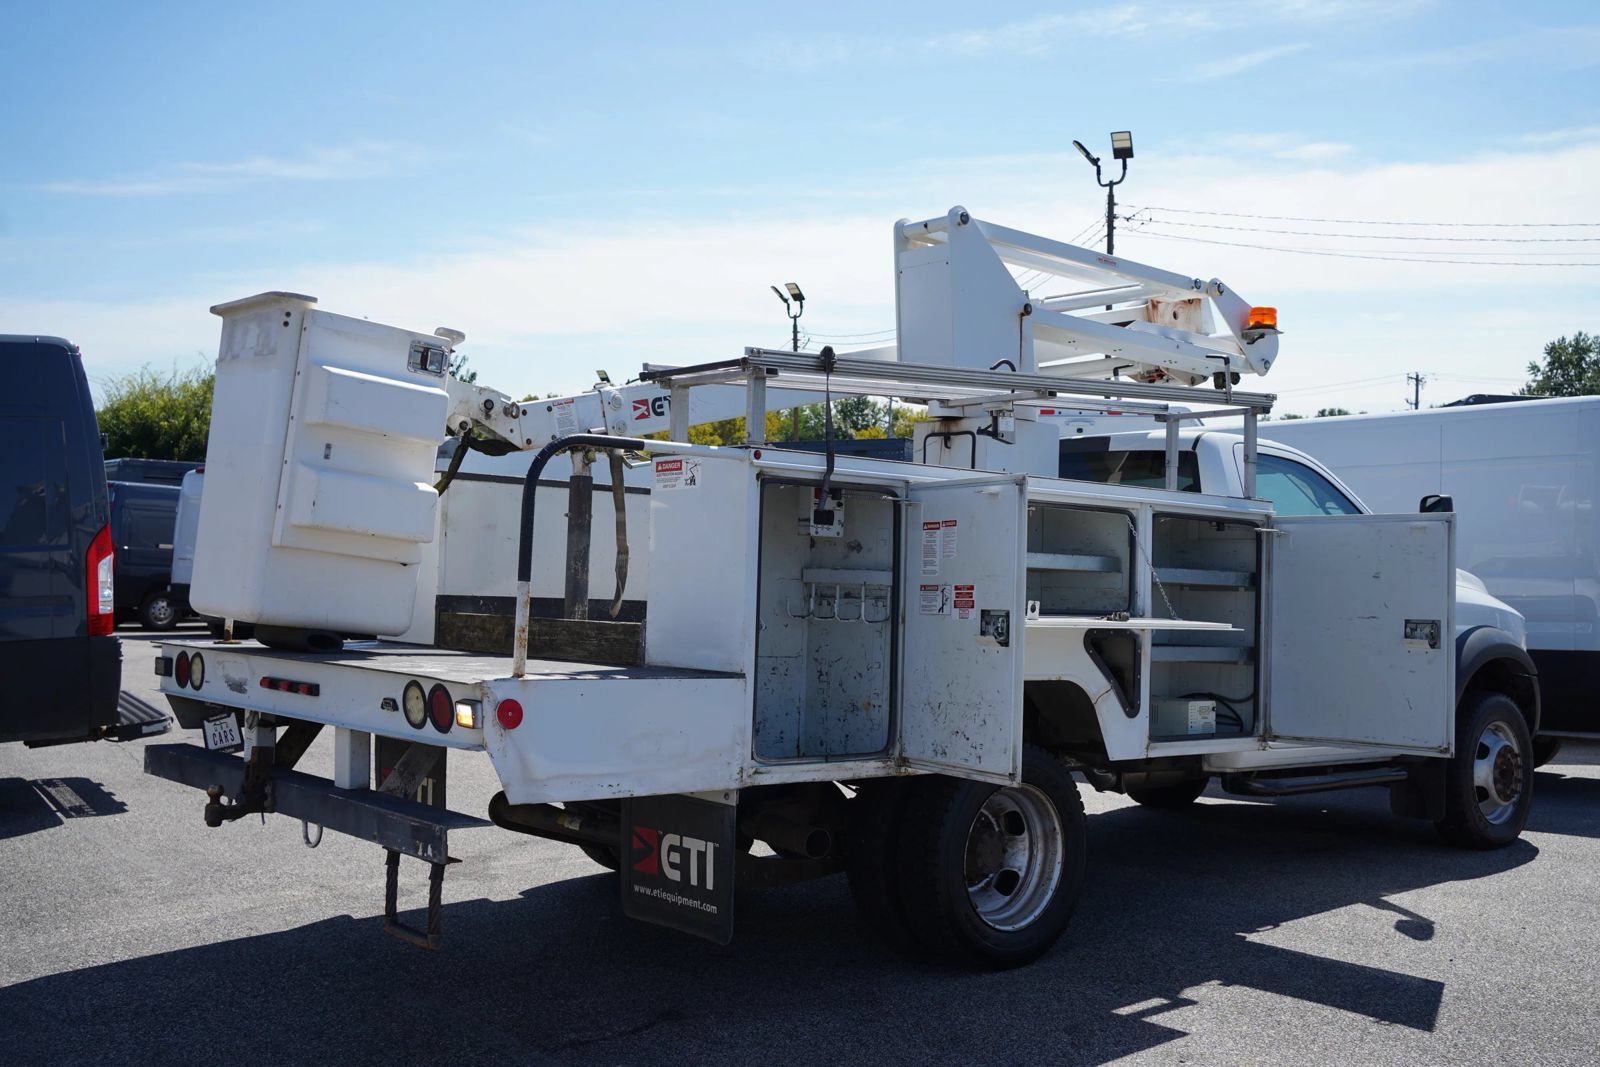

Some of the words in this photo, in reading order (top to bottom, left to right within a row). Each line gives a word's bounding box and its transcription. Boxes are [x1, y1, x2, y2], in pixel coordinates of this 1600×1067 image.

[662, 462, 681, 470] DANGER
[212, 728, 235, 746] CARS
[661, 833, 714, 890] ETI
[634, 884, 718, 914] www.etiequipment.com
